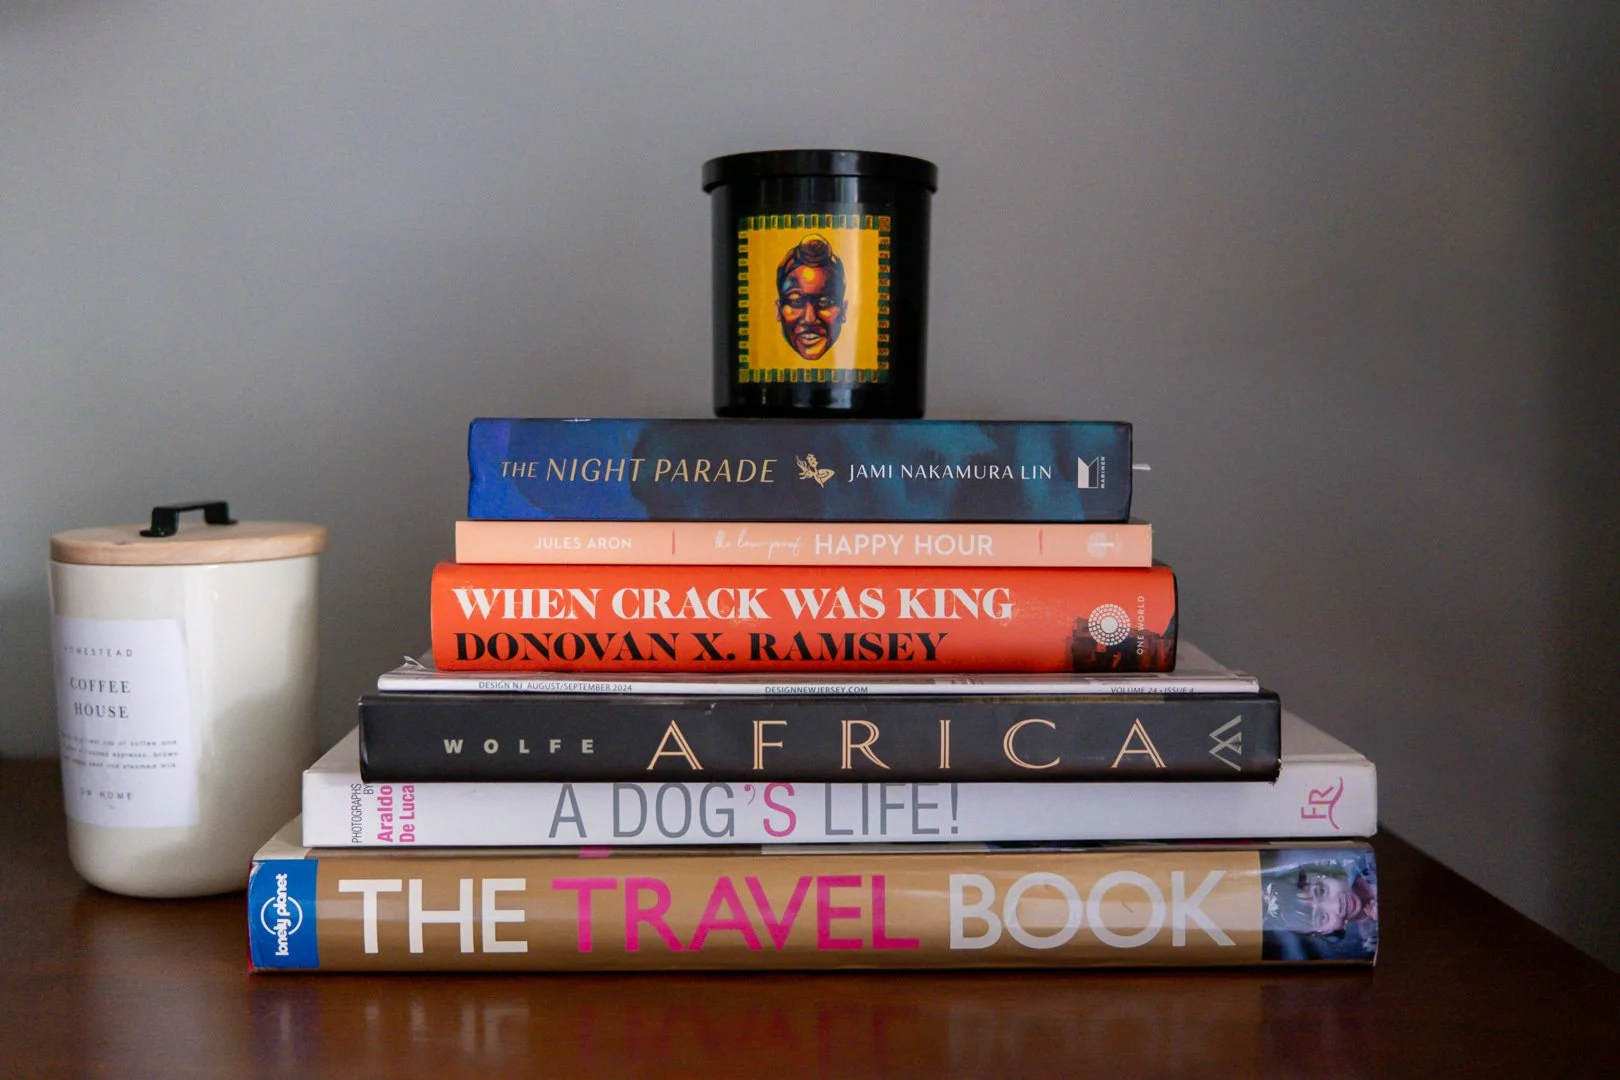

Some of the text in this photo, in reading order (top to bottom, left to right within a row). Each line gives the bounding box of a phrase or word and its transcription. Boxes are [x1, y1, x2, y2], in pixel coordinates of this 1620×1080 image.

[501, 458, 778, 483] THE NIGHT PARADE
[848, 463, 1052, 483] JAMI NAKAMURA LIN
[534, 537, 632, 550] JULES ARON
[814, 533, 994, 556] HAPPY HOUR
[451, 585, 1016, 621] WHEN CRACK WAS KING
[1136, 595, 1145, 656] ONE WORLD
[454, 630, 949, 662] DONOVAN X. RAMSEY
[69, 677, 132, 694] COFFEE
[478, 681, 633, 692] DESIGN NJ AUGUST/SEPTEMBER 2024
[765, 686, 869, 694] DESIGNNEWJERSEY.COM
[74, 702, 129, 719] HOUSE
[444, 738, 595, 755] WOLFE
[646, 718, 1167, 771] AFRICA
[99, 791, 134, 800] HOME
[363, 783, 374, 795] BY
[351, 783, 363, 843] PHOTOGRAPHS
[377, 785, 393, 842] Araldo
[399, 784, 415, 842] De Luca
[548, 783, 960, 839] A DOG'S LIFE!
[273, 873, 292, 956] lonely planet
[338, 870, 1237, 955] THE TRAVEL BOOK
